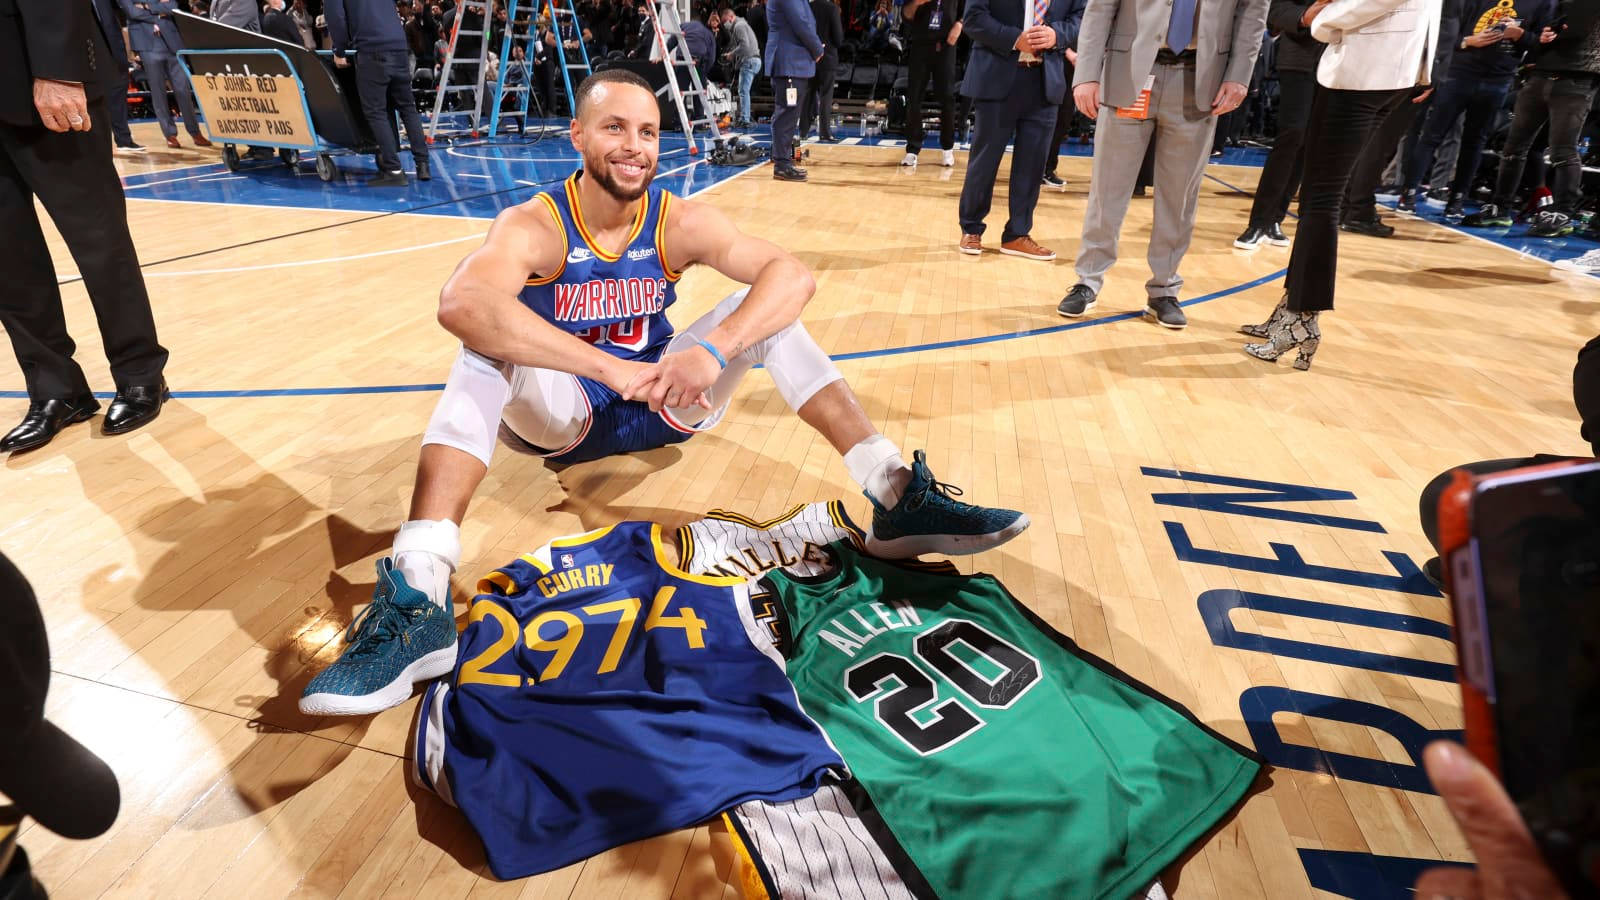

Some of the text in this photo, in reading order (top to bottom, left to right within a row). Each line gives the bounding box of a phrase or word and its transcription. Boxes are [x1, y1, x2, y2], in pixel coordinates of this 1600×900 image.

[206, 76, 277, 93] ST JOHNS RED
[219, 97, 280, 114] BASKETBALL
[217, 119, 293, 136] BACKSTOP PADS
[572, 246, 590, 257] NIKE
[628, 247, 656, 259] Rakuten
[554, 278, 667, 321] WARRIORS
[702, 541, 832, 577] MILLE
[536, 563, 614, 598] CURRY
[818, 600, 922, 657] ALLEN
[844, 618, 1043, 756] 20
